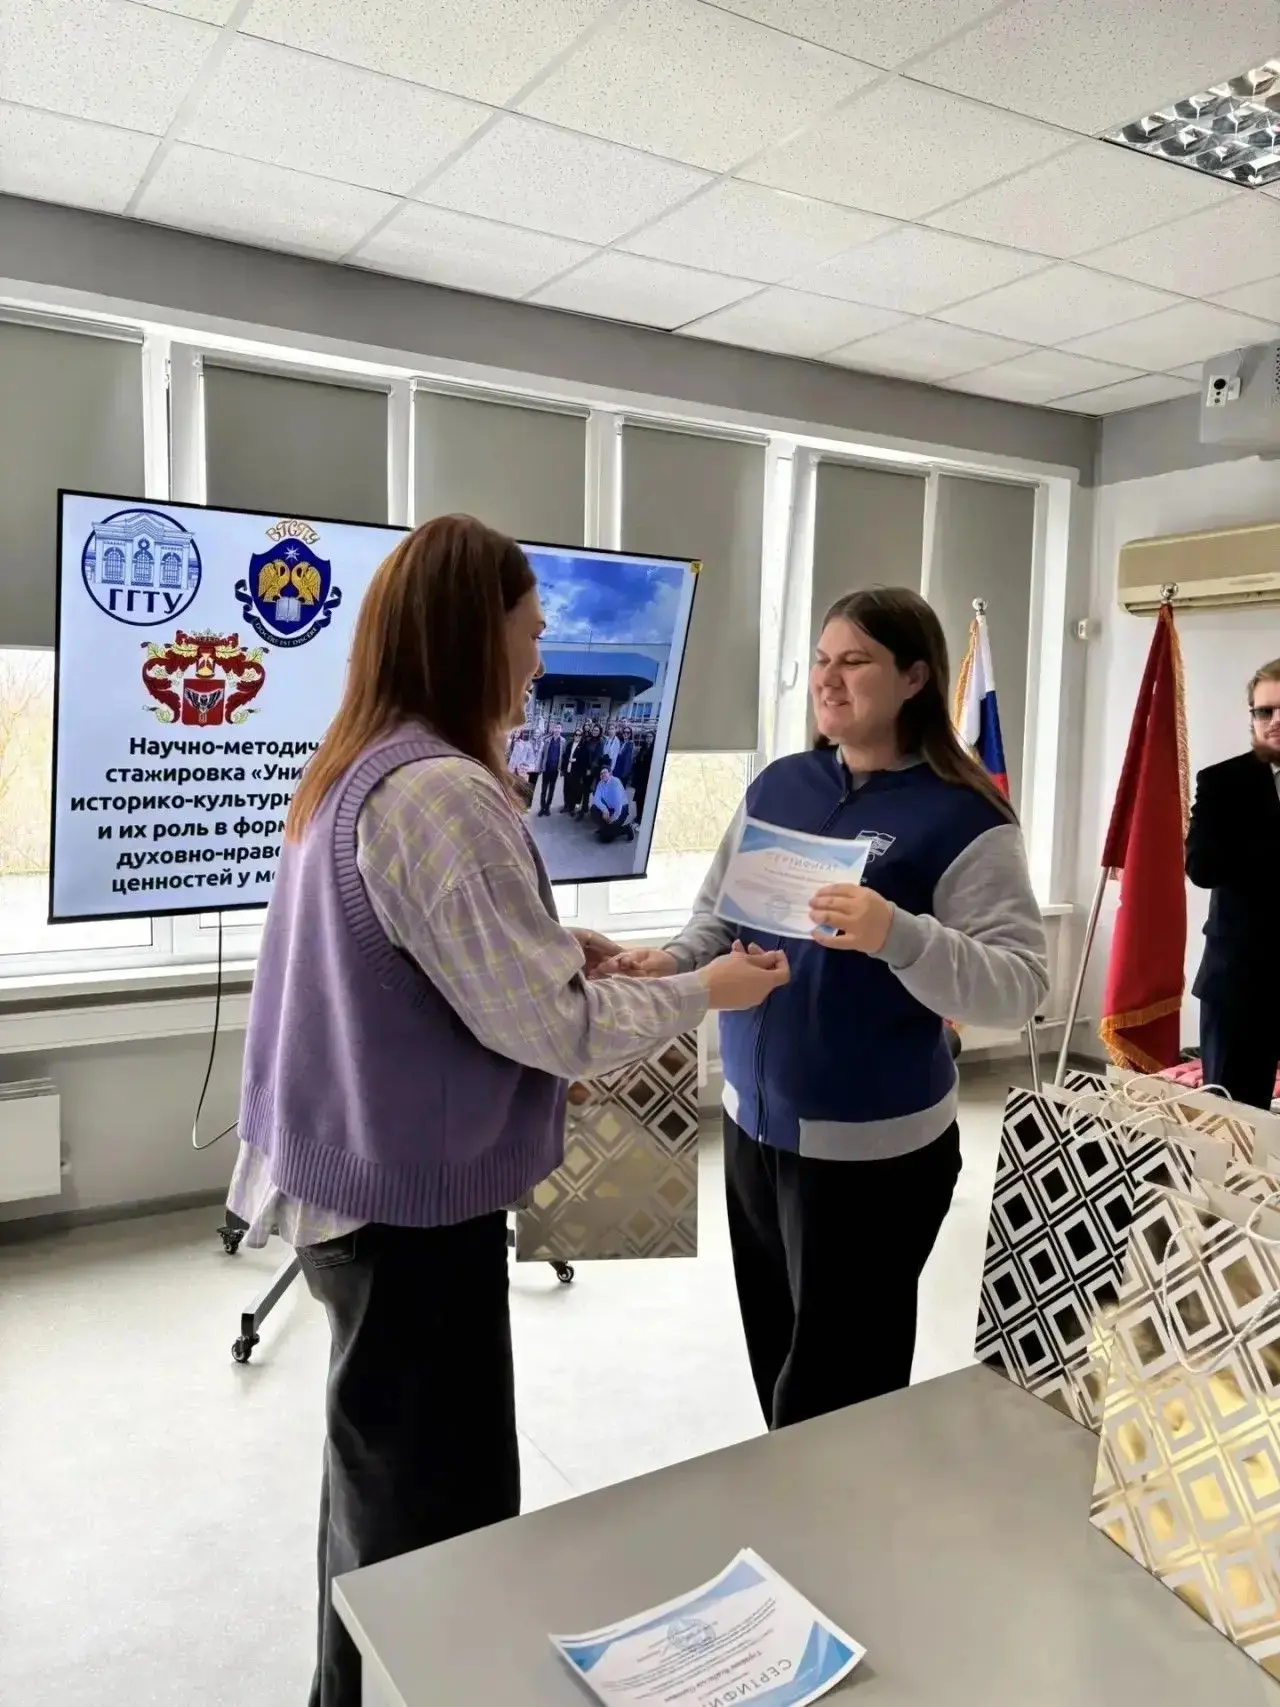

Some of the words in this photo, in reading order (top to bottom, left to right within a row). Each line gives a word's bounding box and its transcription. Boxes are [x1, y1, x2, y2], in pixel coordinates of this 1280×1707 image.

[265, 520, 320, 545] ВГСПУ
[108, 588, 184, 614] ГГТУ
[129, 737, 319, 759] Научно-методич
[105, 766, 246, 785] стажировка
[70, 792, 293, 813] историко-культурн
[98, 825, 112, 839] и
[119, 823, 146, 839] их
[153, 822, 209, 841] роль
[215, 821, 228, 836] в
[112, 868, 233, 894] ценностей
[237, 871, 250, 888] у
[255, 870, 276, 884] м
[702, 1658, 792, 1707] СЕРТИФИ
